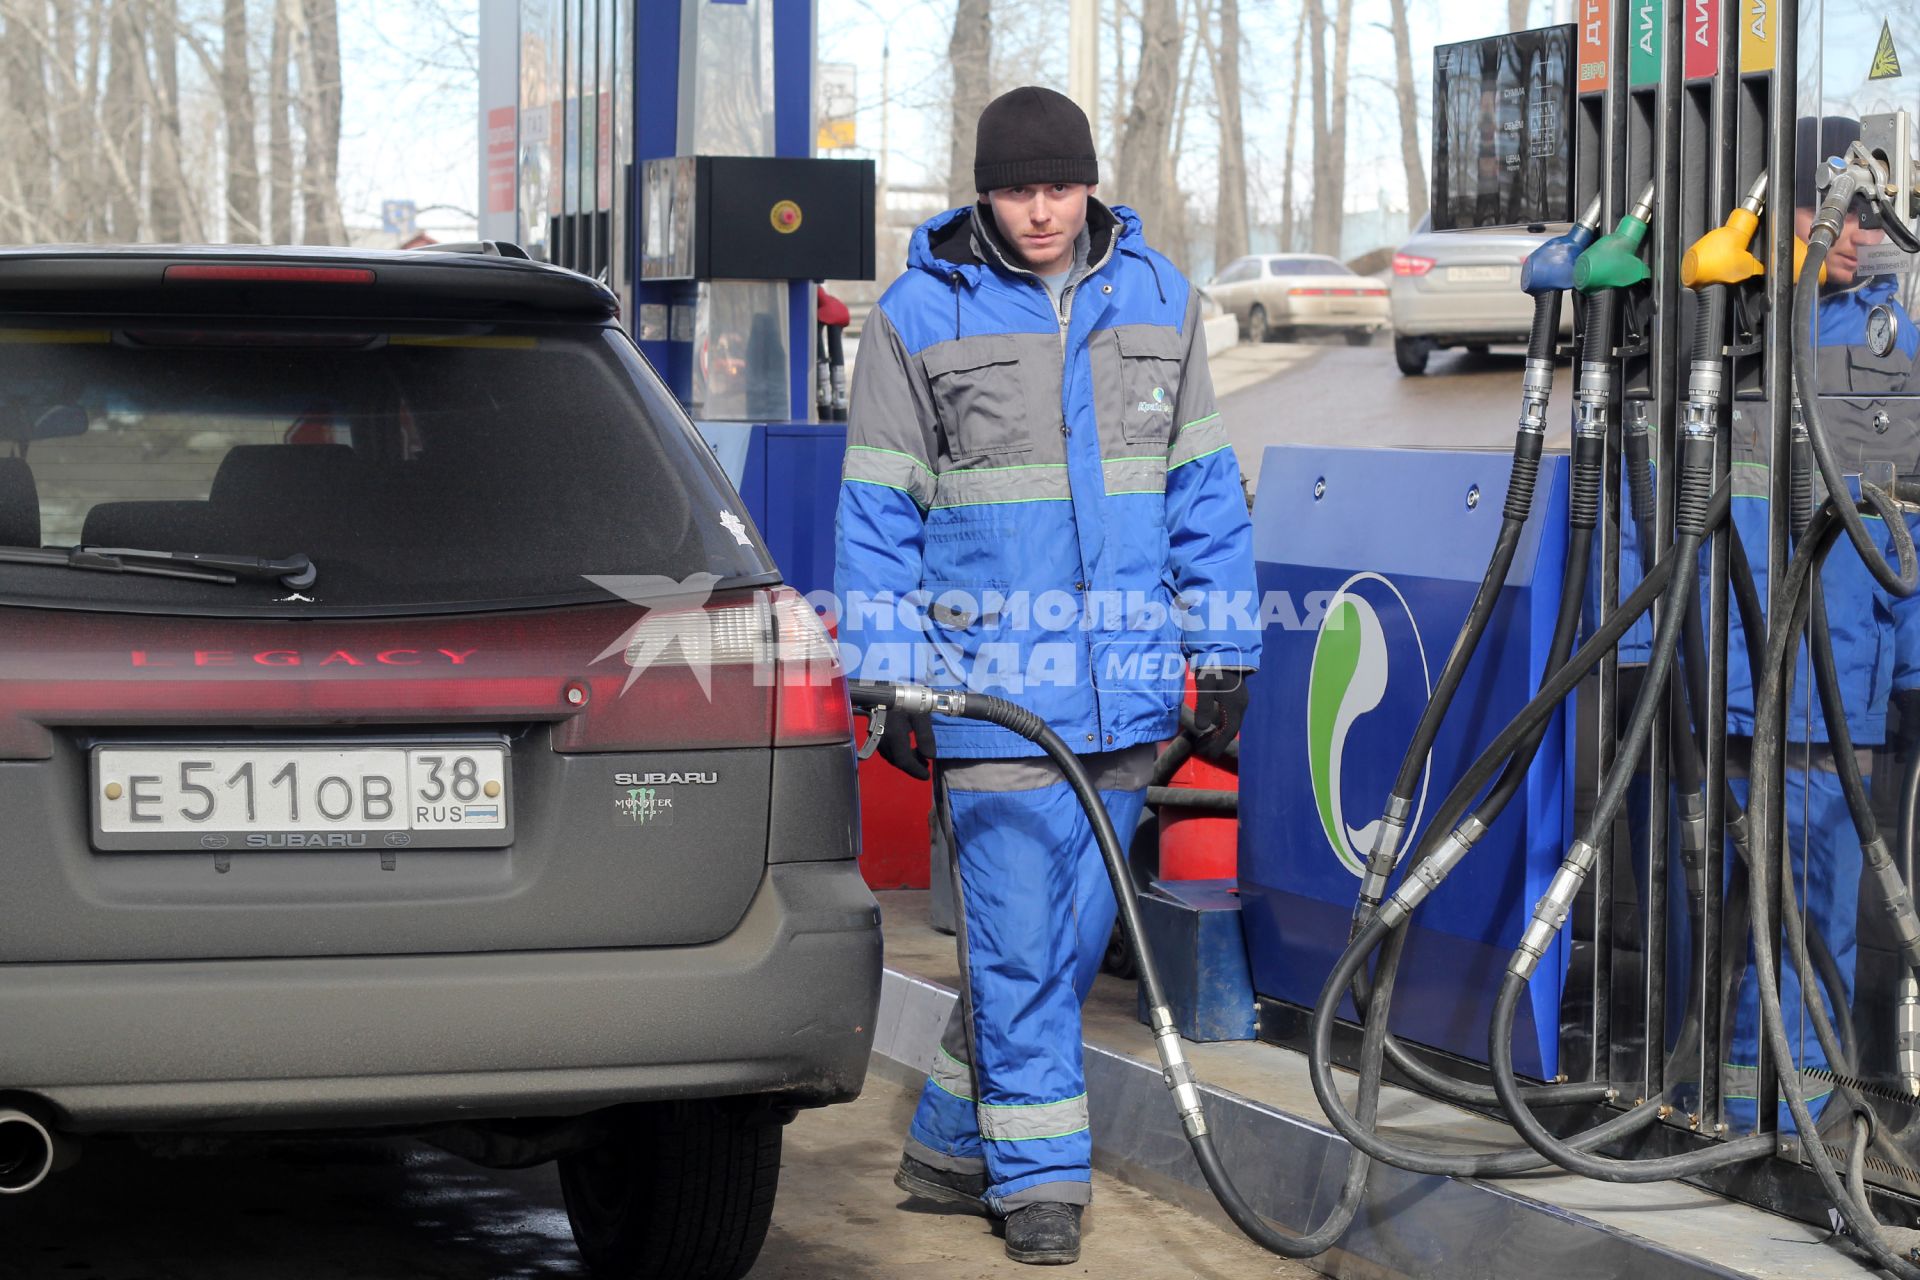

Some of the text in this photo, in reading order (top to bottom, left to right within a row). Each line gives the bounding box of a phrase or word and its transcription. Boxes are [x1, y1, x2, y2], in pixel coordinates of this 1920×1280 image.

[1580, 60, 1606, 81] ЕВРО
[1503, 87, 1526, 98] СУММА
[1505, 154, 1521, 165] ЦЕНА
[130, 648, 480, 667] LEGACY
[418, 756, 481, 802] 38
[614, 772, 718, 786] SUBARU
[615, 797, 673, 810] MONSTER
[416, 806, 463, 823] RUS
[246, 833, 367, 847] SUBARU
